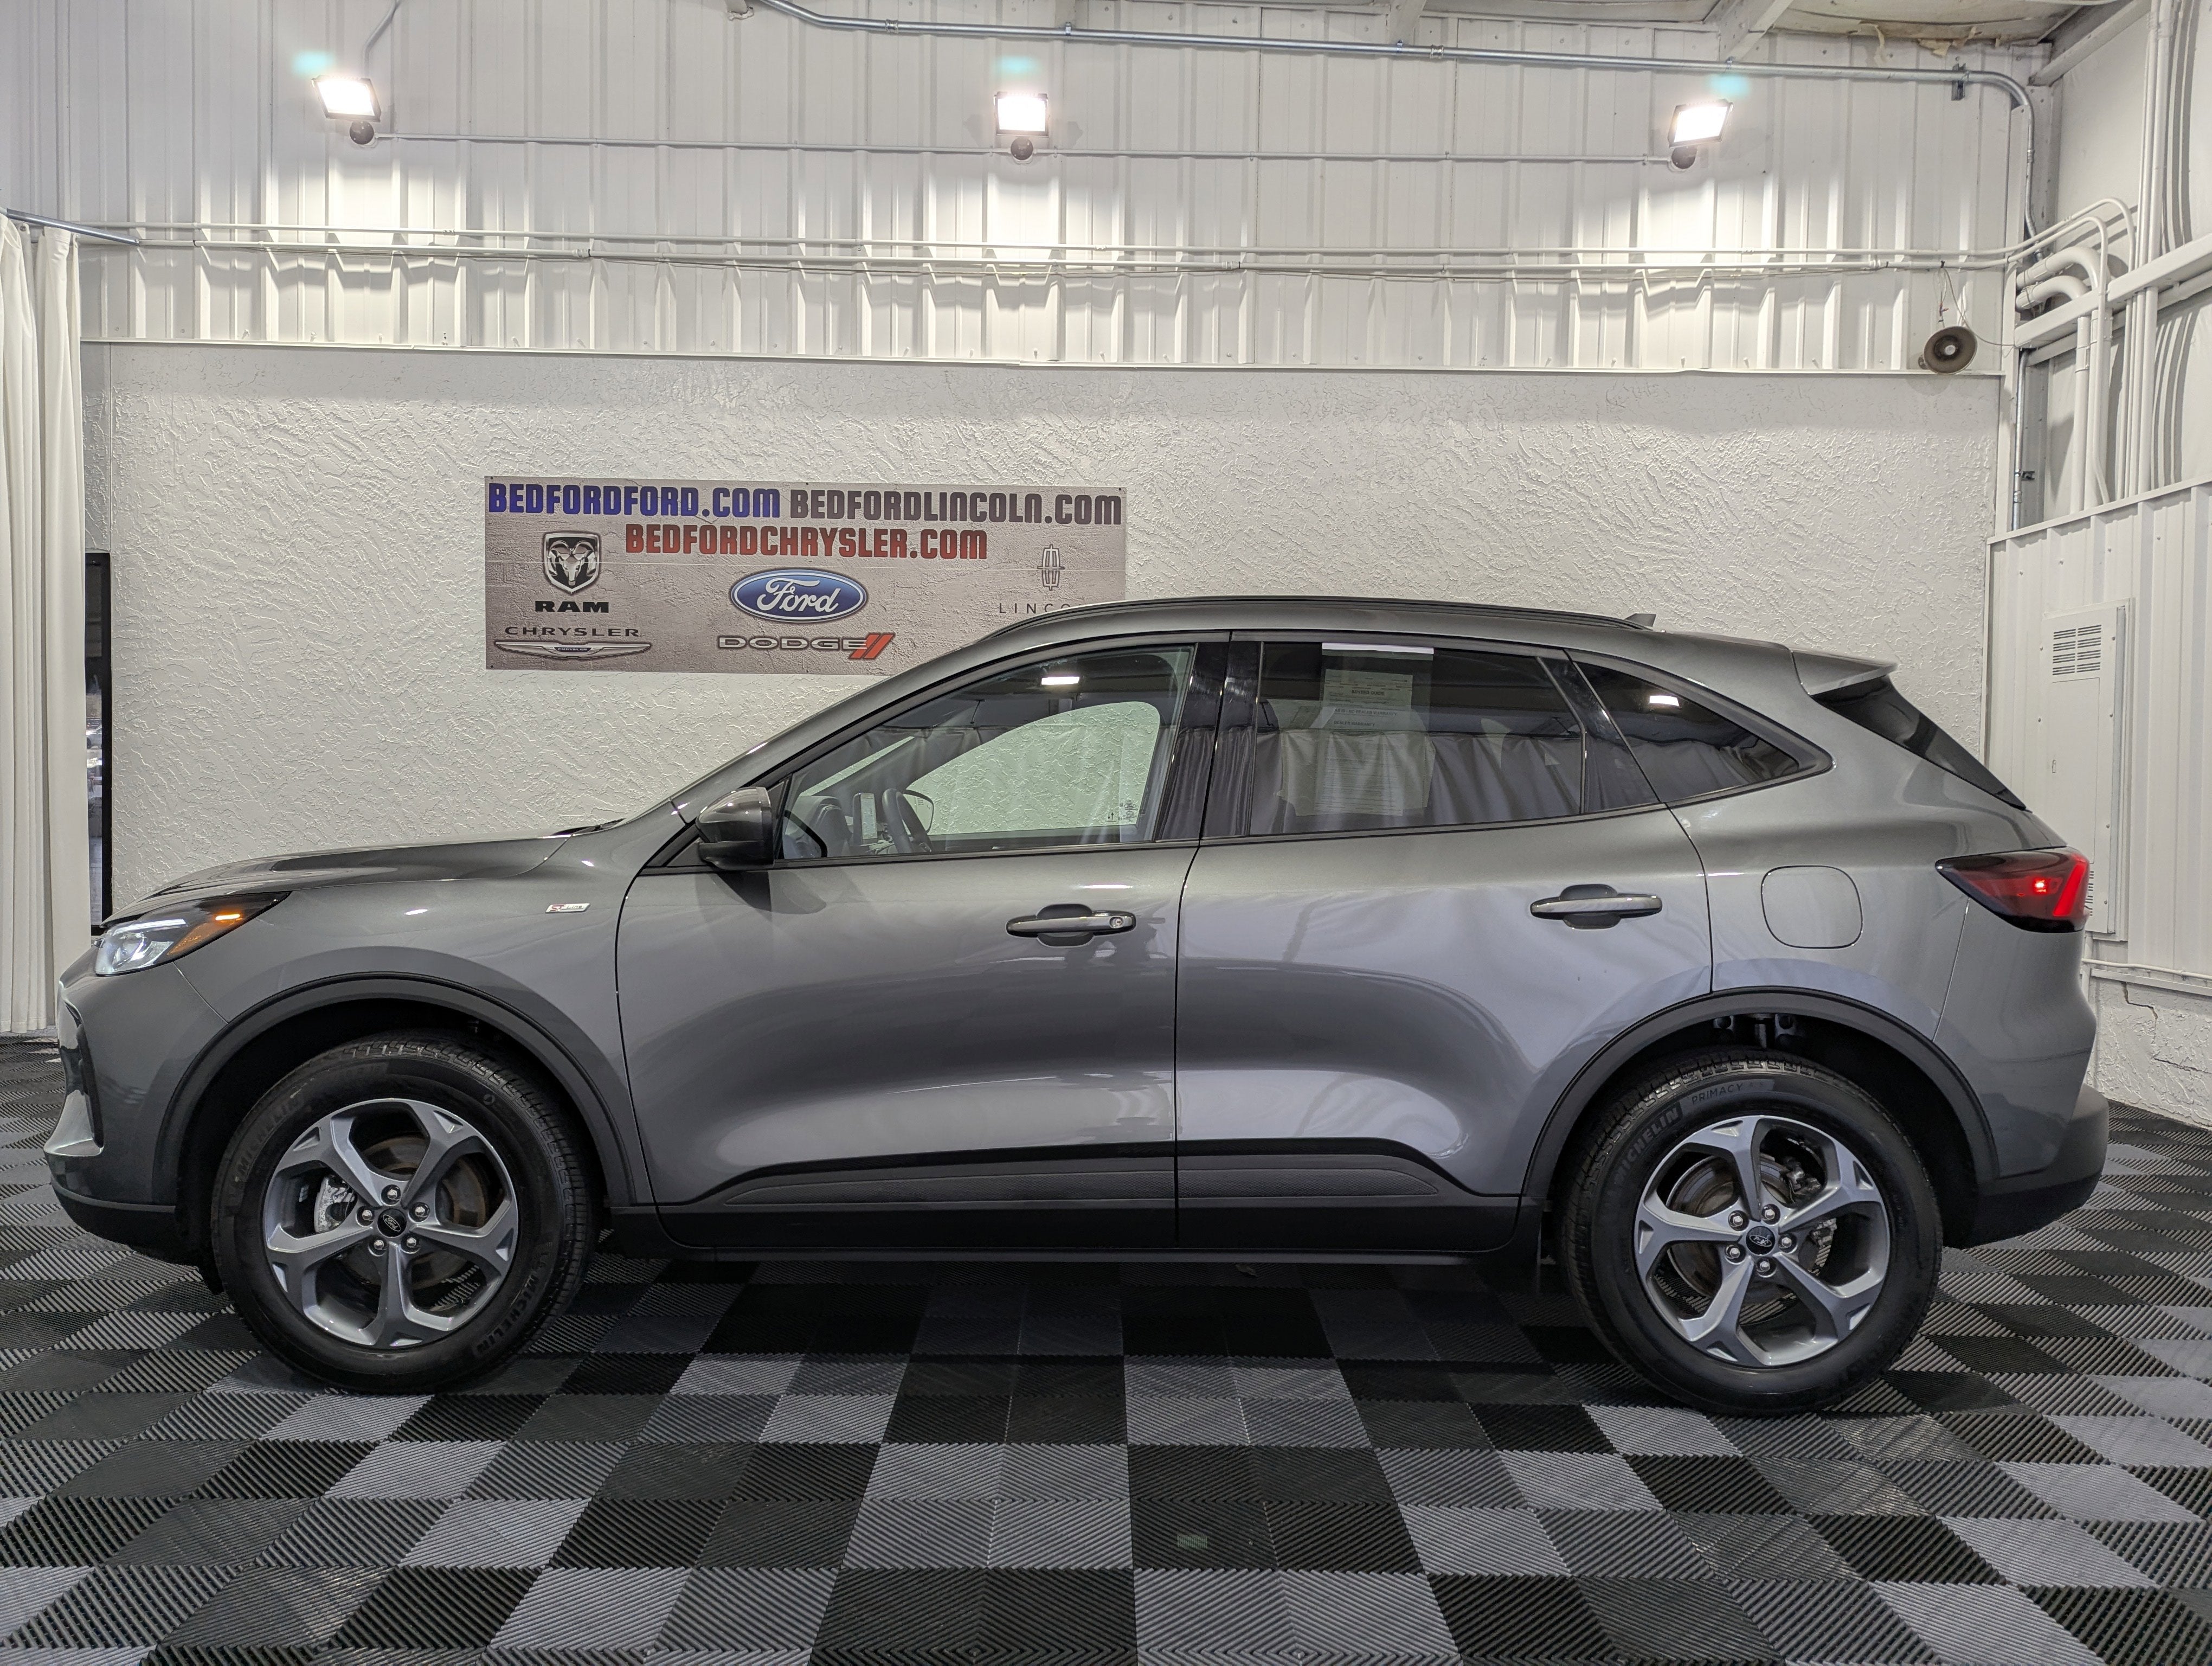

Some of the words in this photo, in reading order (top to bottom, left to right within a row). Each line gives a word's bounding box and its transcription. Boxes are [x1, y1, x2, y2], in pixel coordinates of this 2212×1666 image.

[488, 483, 780, 518] BEDFORDFORD.COM
[790, 489, 1122, 526] BEDFORDLINCOLN.COM
[626, 523, 987, 560] BEDFORDCHRYSLER.COM
[757, 577, 841, 613] Ford
[535, 600, 609, 613] RAM
[999, 603, 1072, 614] LINC
[504, 626, 640, 637] CHRYSLER
[717, 636, 868, 651] DODGE
[1691, 1082, 1744, 1105] PRIMACY
